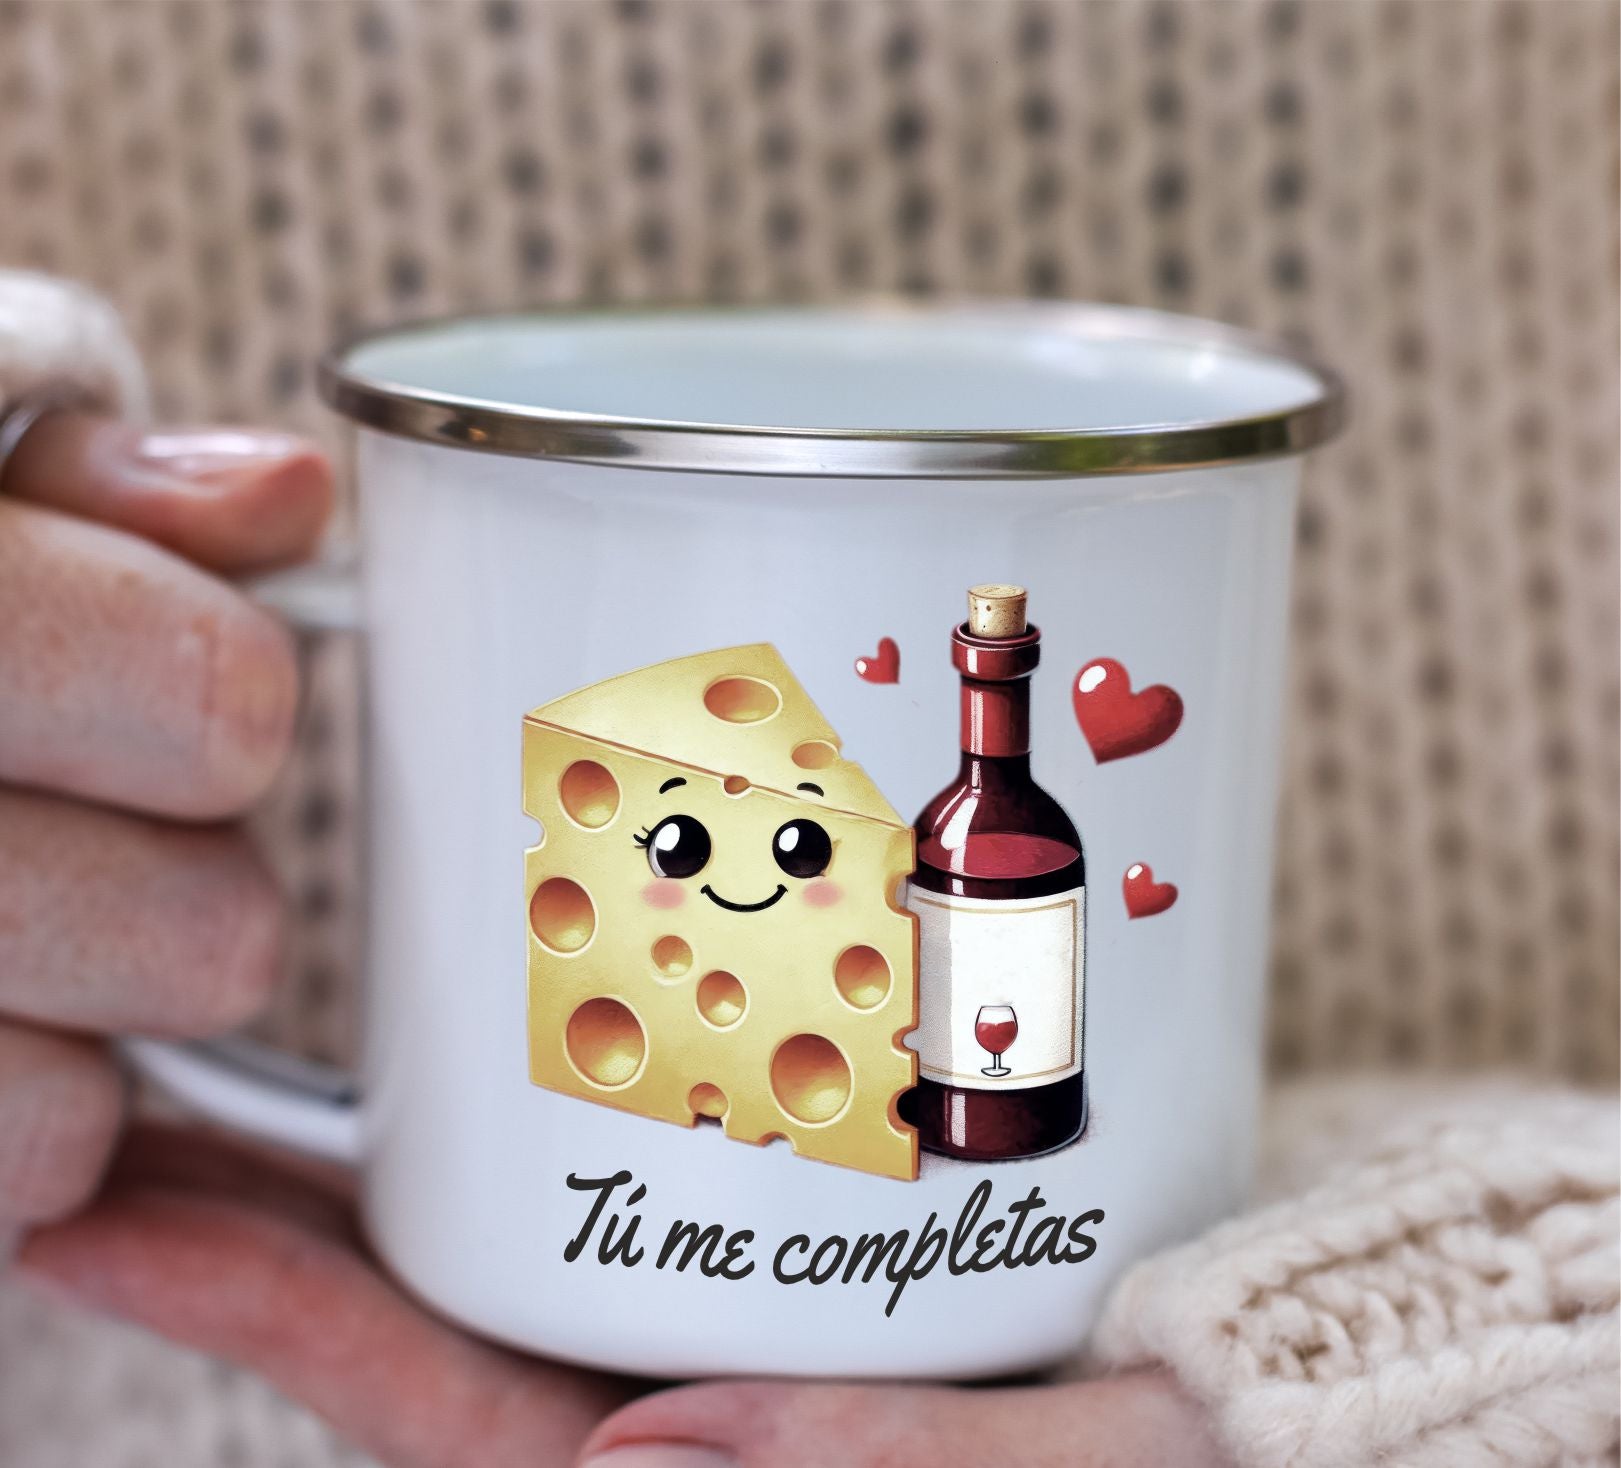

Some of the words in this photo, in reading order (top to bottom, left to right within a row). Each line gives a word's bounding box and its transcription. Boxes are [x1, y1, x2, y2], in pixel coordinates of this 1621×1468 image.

[563, 1169, 647, 1268] Tú
[655, 1219, 755, 1281] me
[772, 1179, 1105, 1318] completas
